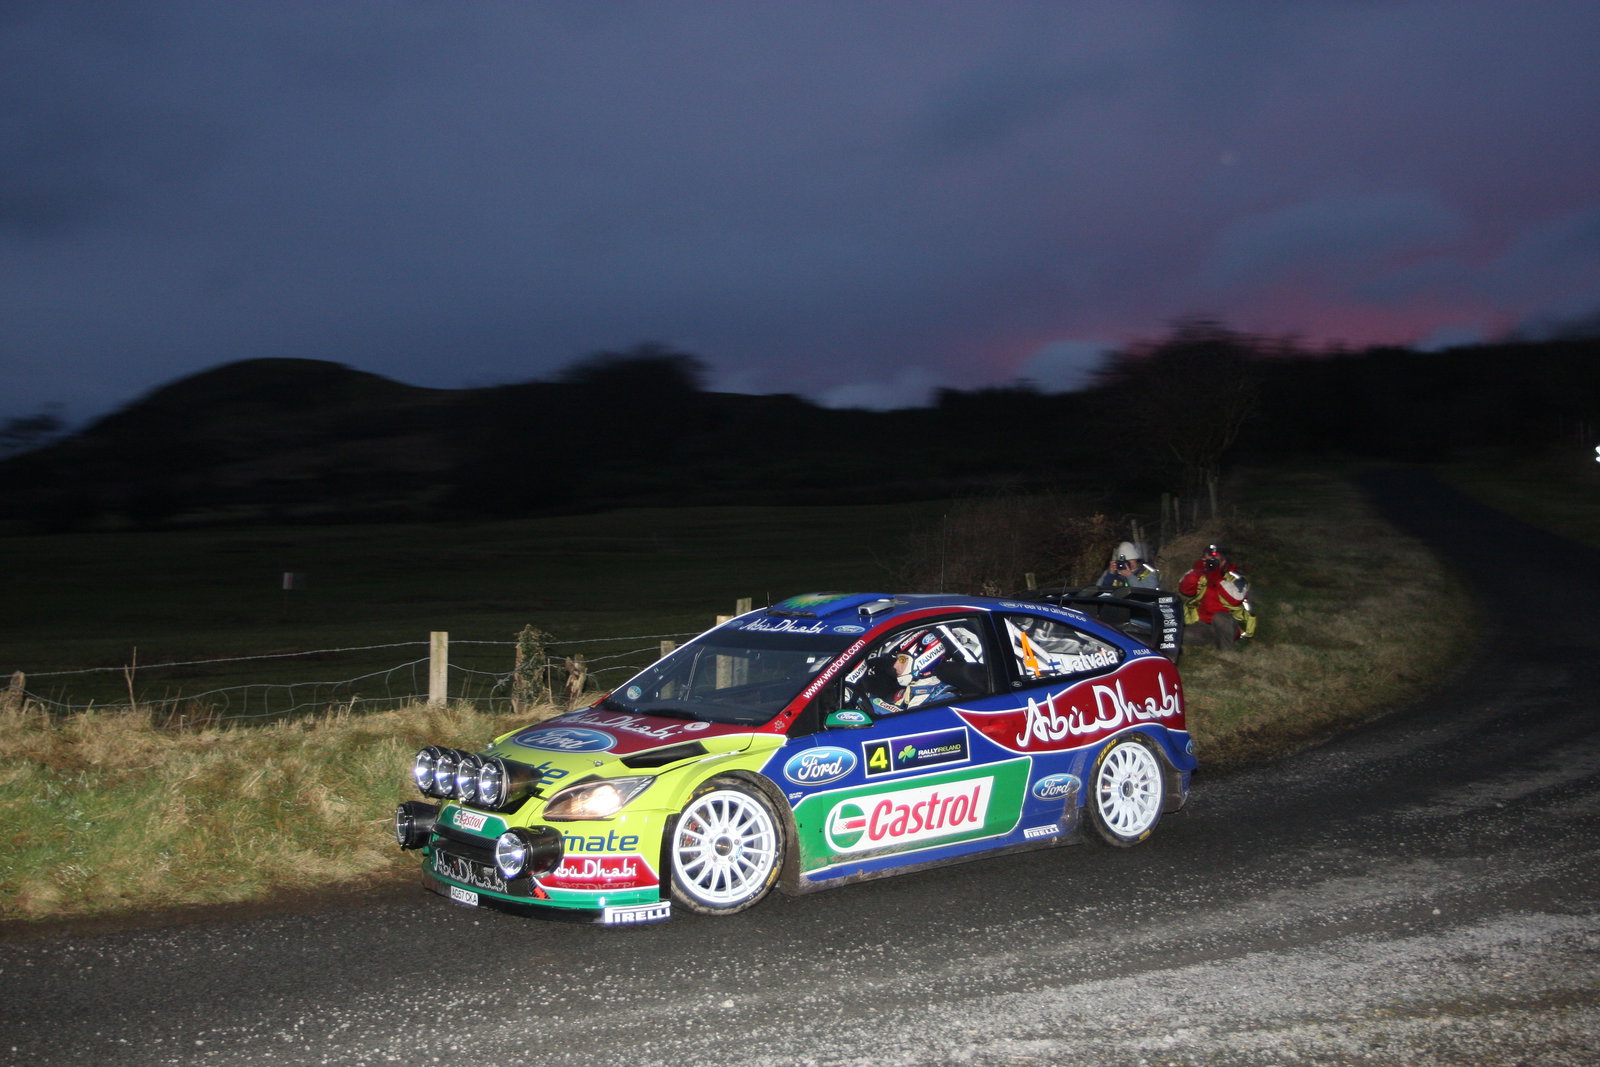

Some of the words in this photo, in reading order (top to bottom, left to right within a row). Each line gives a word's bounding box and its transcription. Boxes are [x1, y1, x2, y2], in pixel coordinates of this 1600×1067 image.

[1021, 631, 1041, 677] 4
[523, 729, 600, 749] Ford
[797, 752, 842, 781] Ford
[868, 746, 889, 769] 4
[1041, 778, 1070, 797] Ford
[460, 812, 484, 829] Castrol
[868, 784, 982, 841] Castrol
[561, 830, 638, 852] mate
[1023, 824, 1060, 839] PIRELLI
[603, 901, 671, 924] PIRELLI
